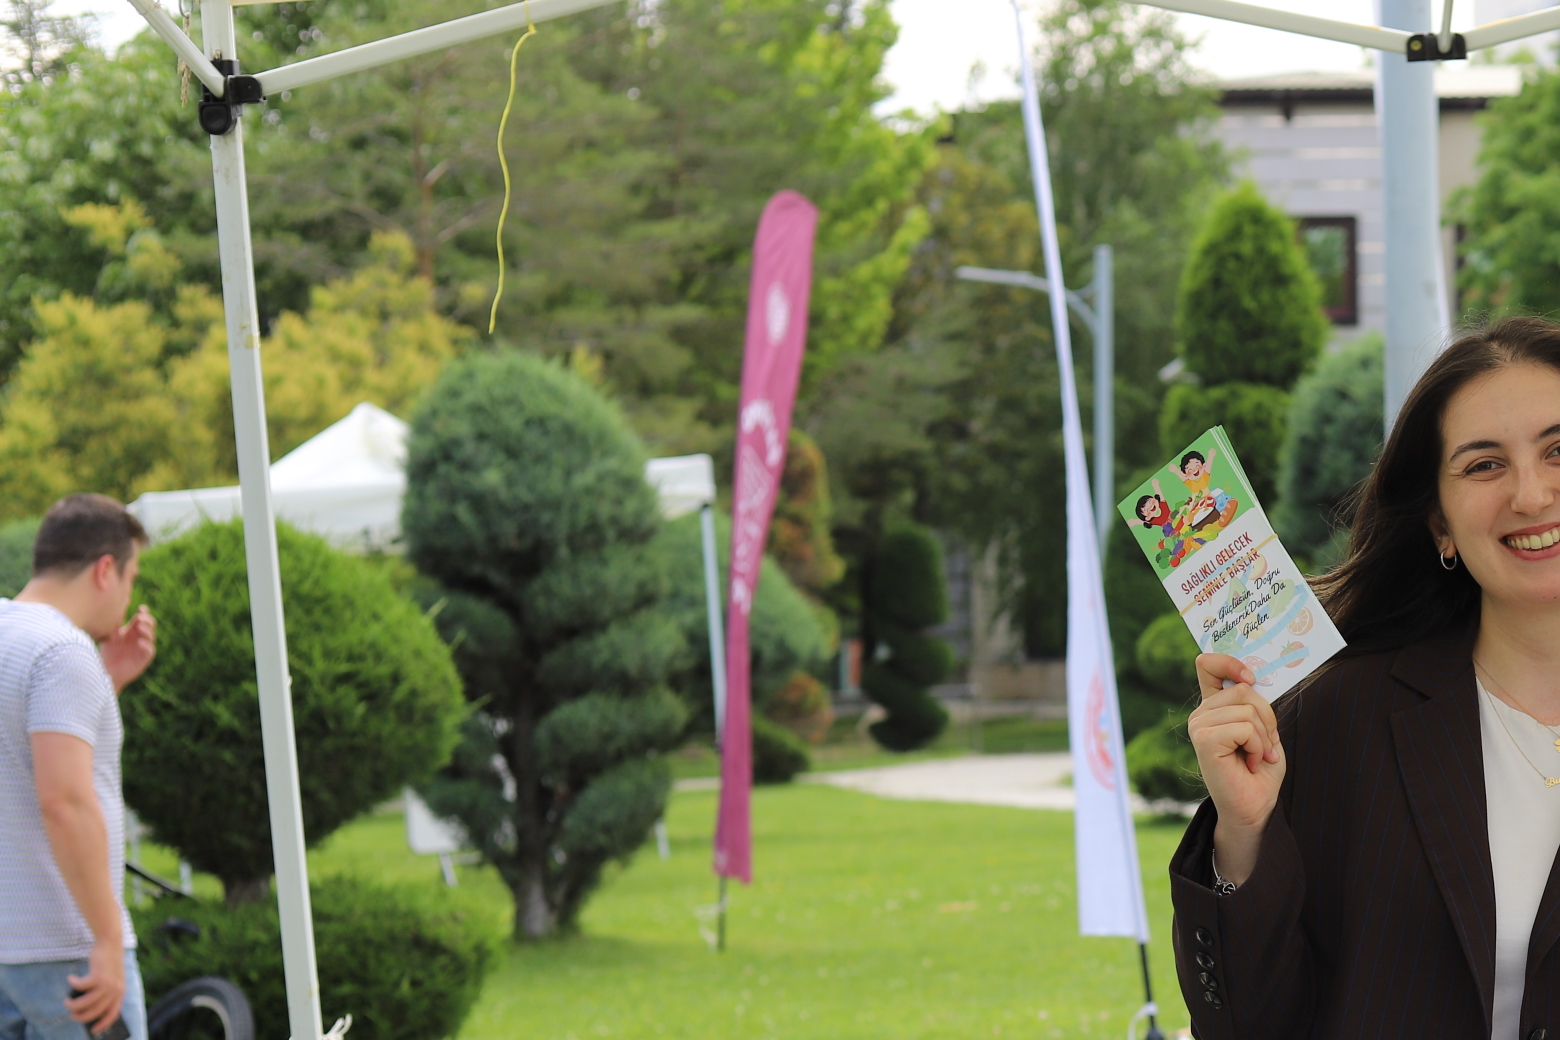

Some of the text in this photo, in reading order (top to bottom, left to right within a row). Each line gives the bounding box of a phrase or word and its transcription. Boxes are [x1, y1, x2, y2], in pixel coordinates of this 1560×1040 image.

[1181, 531, 1253, 595] SAĞLIKLI GELECEK
[1203, 617, 1218, 633] Sen
[1254, 568, 1280, 590] Doğru
[1211, 582, 1286, 643] Beslenerek Daha Da
[1242, 612, 1270, 639] Güçlen
